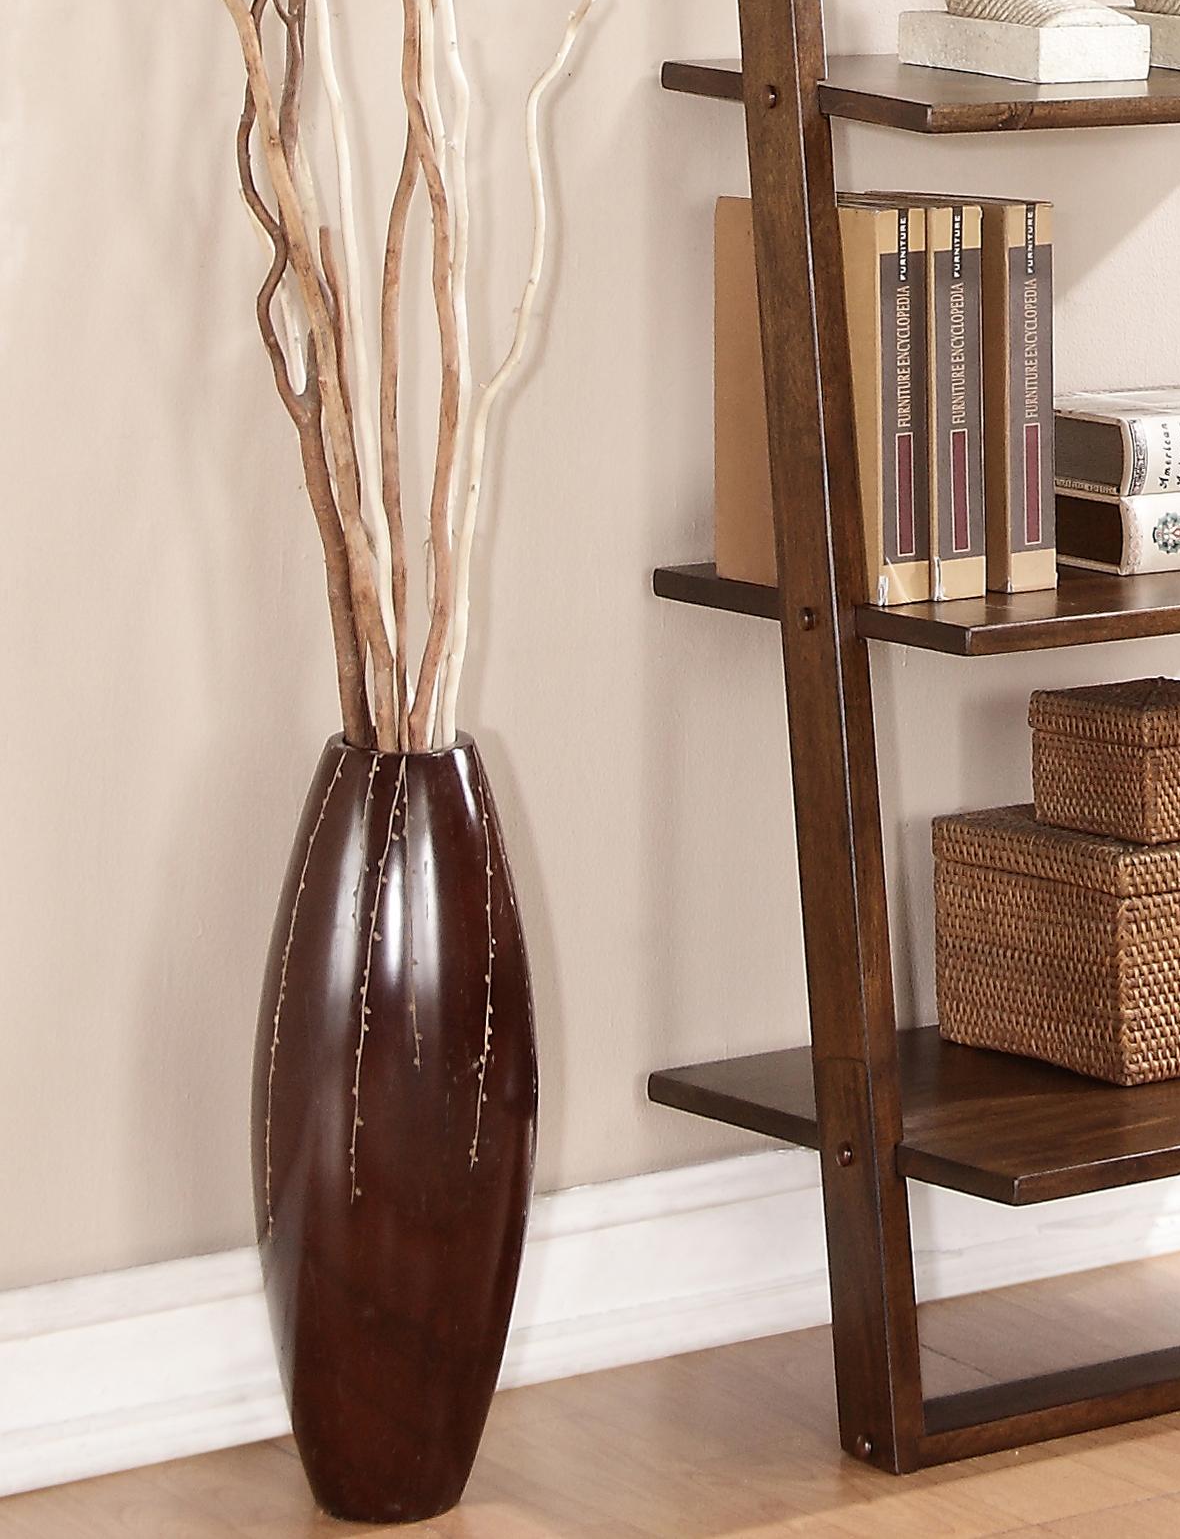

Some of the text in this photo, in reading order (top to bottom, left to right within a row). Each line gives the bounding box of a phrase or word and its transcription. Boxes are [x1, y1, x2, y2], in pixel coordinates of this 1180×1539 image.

[899, 217, 908, 281] FURNITURE
[953, 214, 961, 278] FURNITURE
[1026, 210, 1034, 274] FURNITURE
[896, 285, 912, 428] FURNITURE ENCYCLOPEDIA
[950, 282, 967, 424] FURNITURE ENCYCLOPEDIA
[1024, 278, 1039, 420] FURNITURE ENCYCLOPEDIA
[1159, 422, 1171, 489] American
